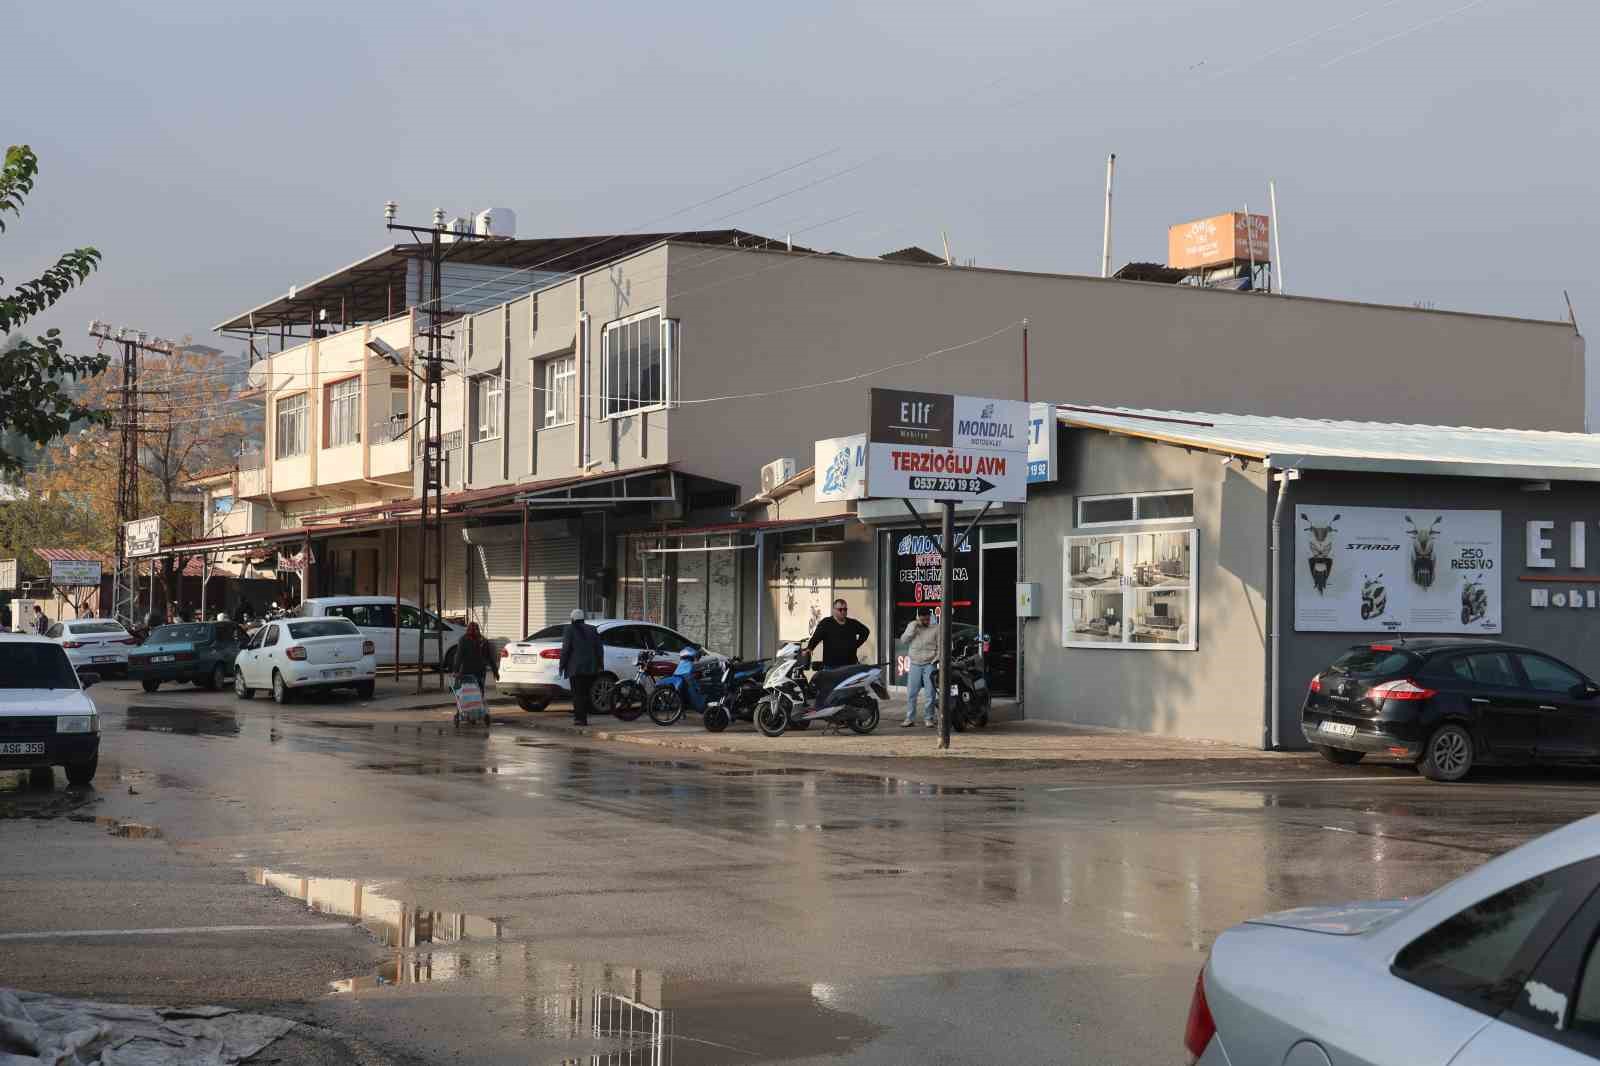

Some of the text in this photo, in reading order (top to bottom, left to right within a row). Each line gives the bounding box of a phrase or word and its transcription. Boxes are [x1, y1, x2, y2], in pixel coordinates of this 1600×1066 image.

[958, 420, 1014, 438] MONDIAL
[891, 448, 973, 474] TERZİOĞLU
[975, 456, 1006, 476] AVM
[958, 479, 967, 490] 19
[969, 480, 980, 491] 92
[1462, 548, 1484, 559] 250
[1451, 559, 1494, 570] RESSIVO
[914, 582, 922, 602] 6
[25, 743, 43, 753] 359
